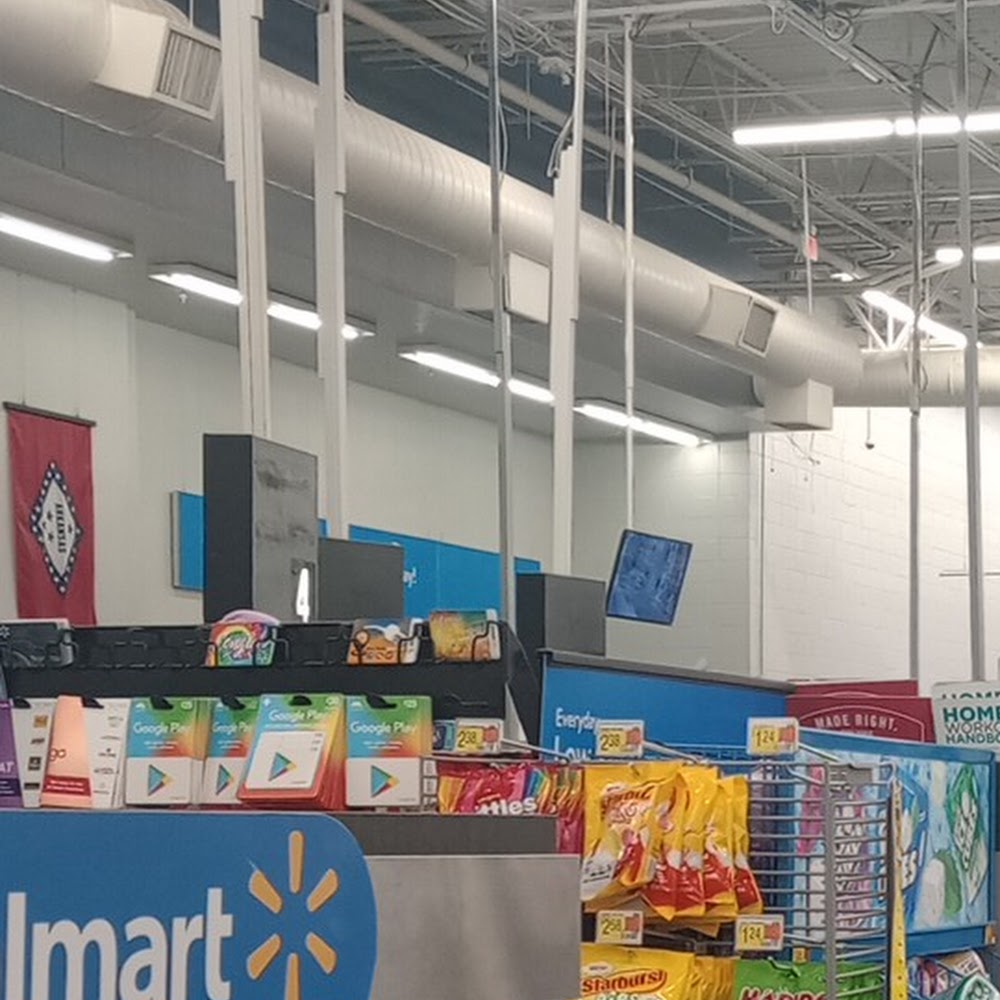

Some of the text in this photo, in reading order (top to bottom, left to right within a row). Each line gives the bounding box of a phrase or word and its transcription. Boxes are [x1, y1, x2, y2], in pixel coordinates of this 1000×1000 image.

[269, 710, 303, 724] Google
[815, 714, 848, 730] MADE
[133, 721, 166, 737] Google
[350, 721, 389, 737] Google
[582, 969, 666, 993] Starburst
